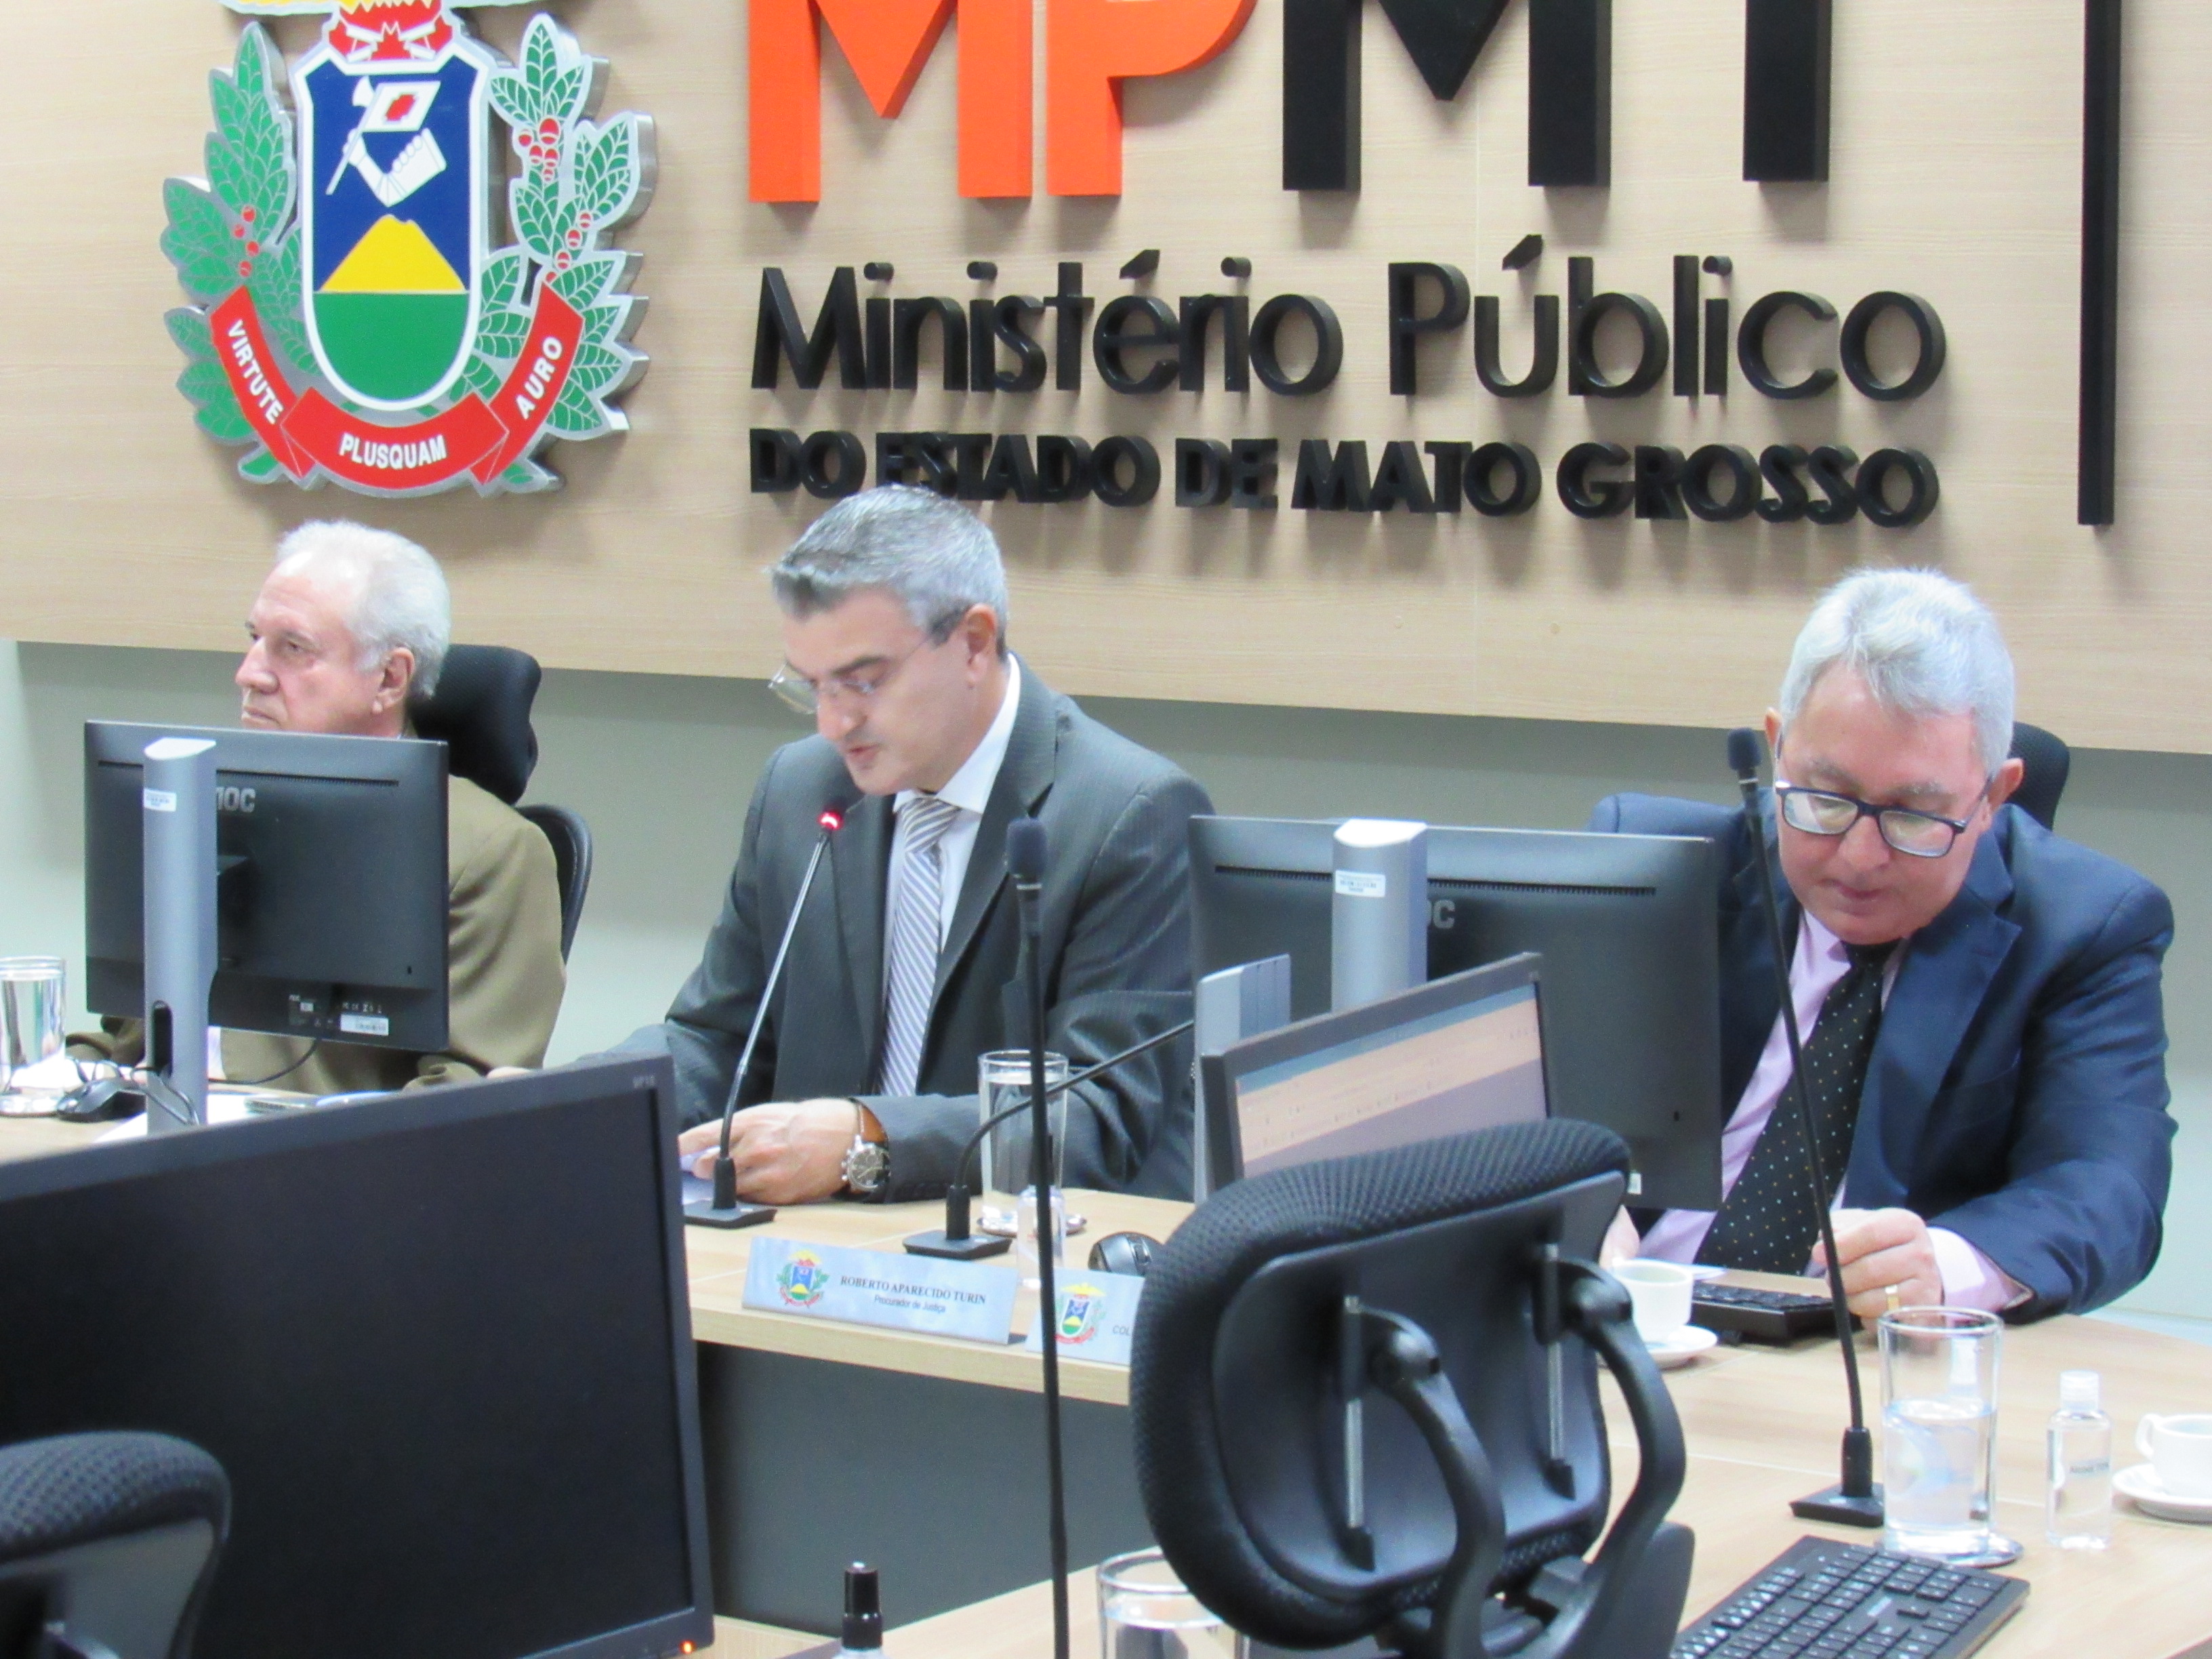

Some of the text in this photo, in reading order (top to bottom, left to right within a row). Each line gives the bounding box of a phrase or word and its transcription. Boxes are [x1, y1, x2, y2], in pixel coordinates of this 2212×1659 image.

[752, 234, 1946, 401] Ministério Público
[228, 319, 284, 425] VIRTUTE
[516, 335, 563, 420] AURO
[338, 432, 447, 470] PLUSQUAM
[749, 428, 1940, 528] DO ESTADO DE MATO GROSSO
[840, 1275, 987, 1305] ROBERTO APARECIDO TURIN
[874, 1295, 911, 1307] Procurador
